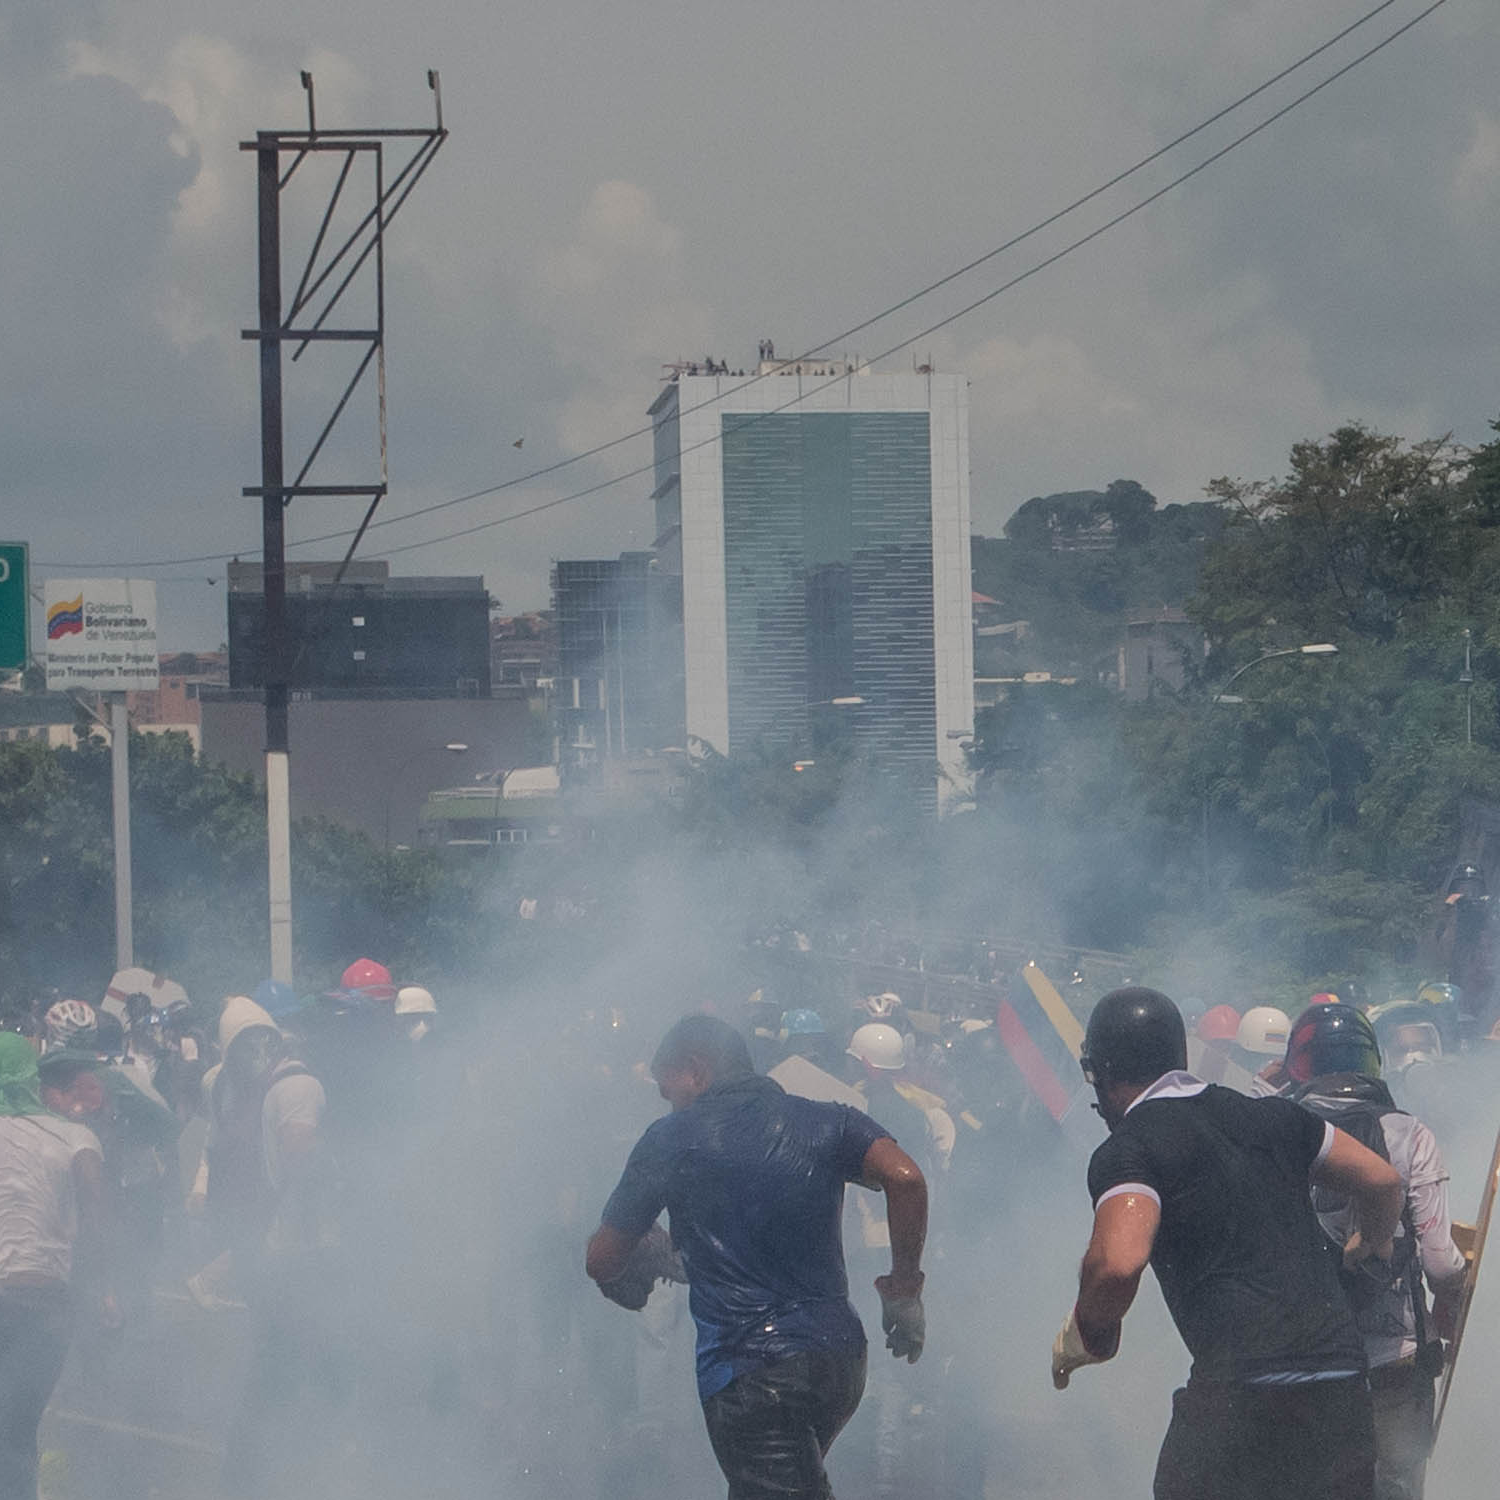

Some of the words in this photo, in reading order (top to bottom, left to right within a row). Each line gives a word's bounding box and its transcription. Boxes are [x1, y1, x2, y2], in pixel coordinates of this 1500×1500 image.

[85, 602, 133, 614] Gobierno
[85, 615, 148, 628] Bolivariano
[85, 629, 99, 640] de
